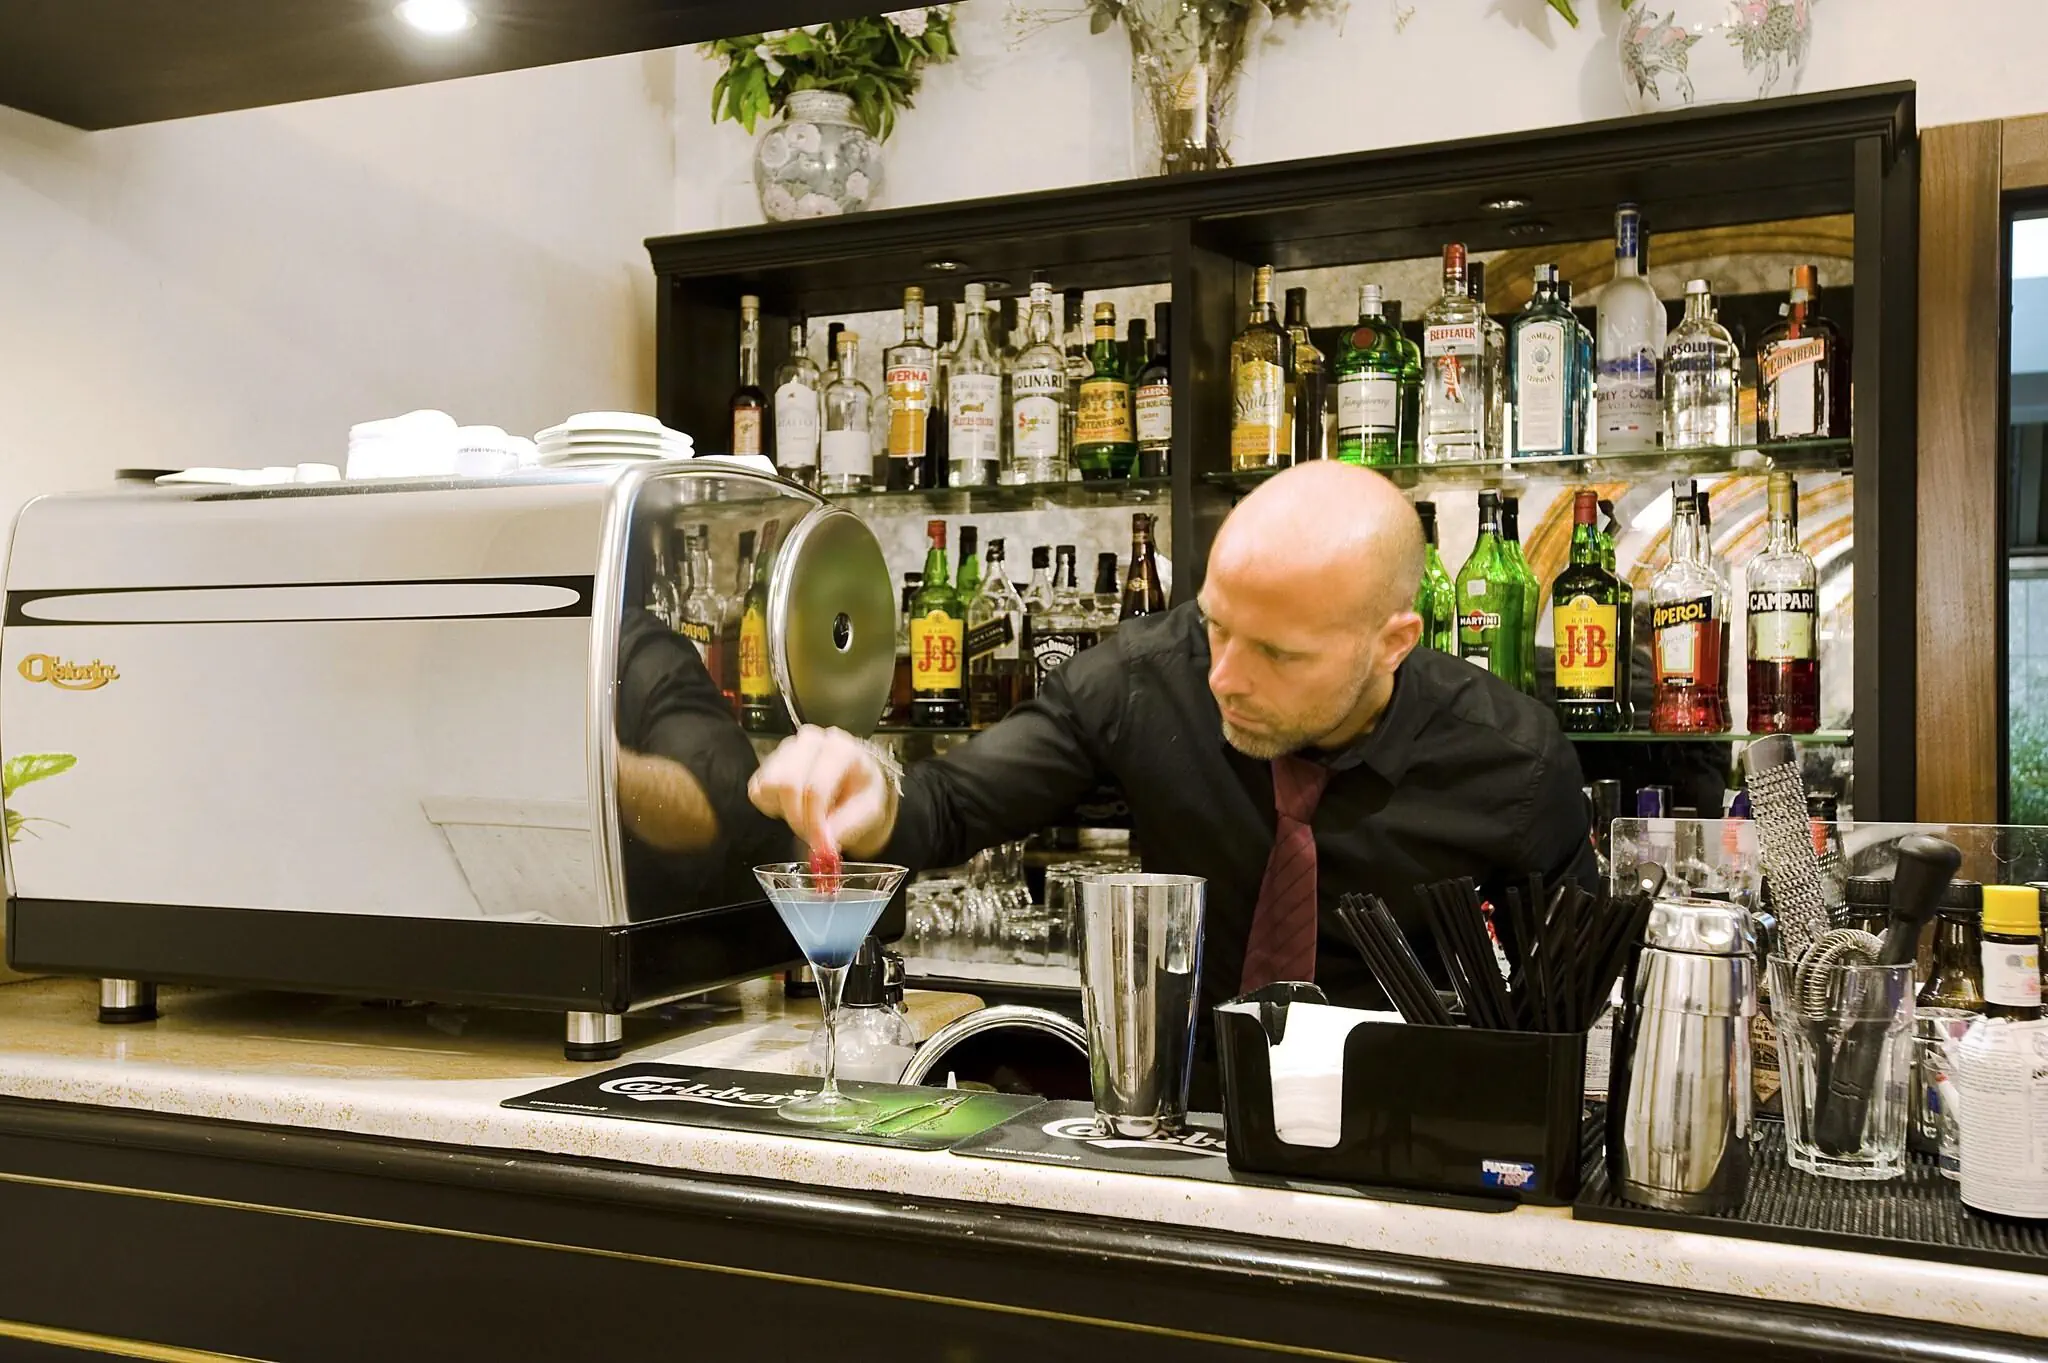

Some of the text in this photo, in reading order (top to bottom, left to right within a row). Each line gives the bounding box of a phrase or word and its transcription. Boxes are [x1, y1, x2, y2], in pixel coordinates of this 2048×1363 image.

[1430, 328, 1475, 341] BEEFEATER
[1769, 343, 1820, 375] COINTREAU
[1014, 374, 1062, 389] OLINARI
[1750, 592, 1813, 611] CAMPARI
[1460, 615, 1497, 625] MARTINI
[1653, 602, 1706, 628] APEROL
[917, 635, 956, 673] J&B
[1560, 624, 1607, 668] J&B
